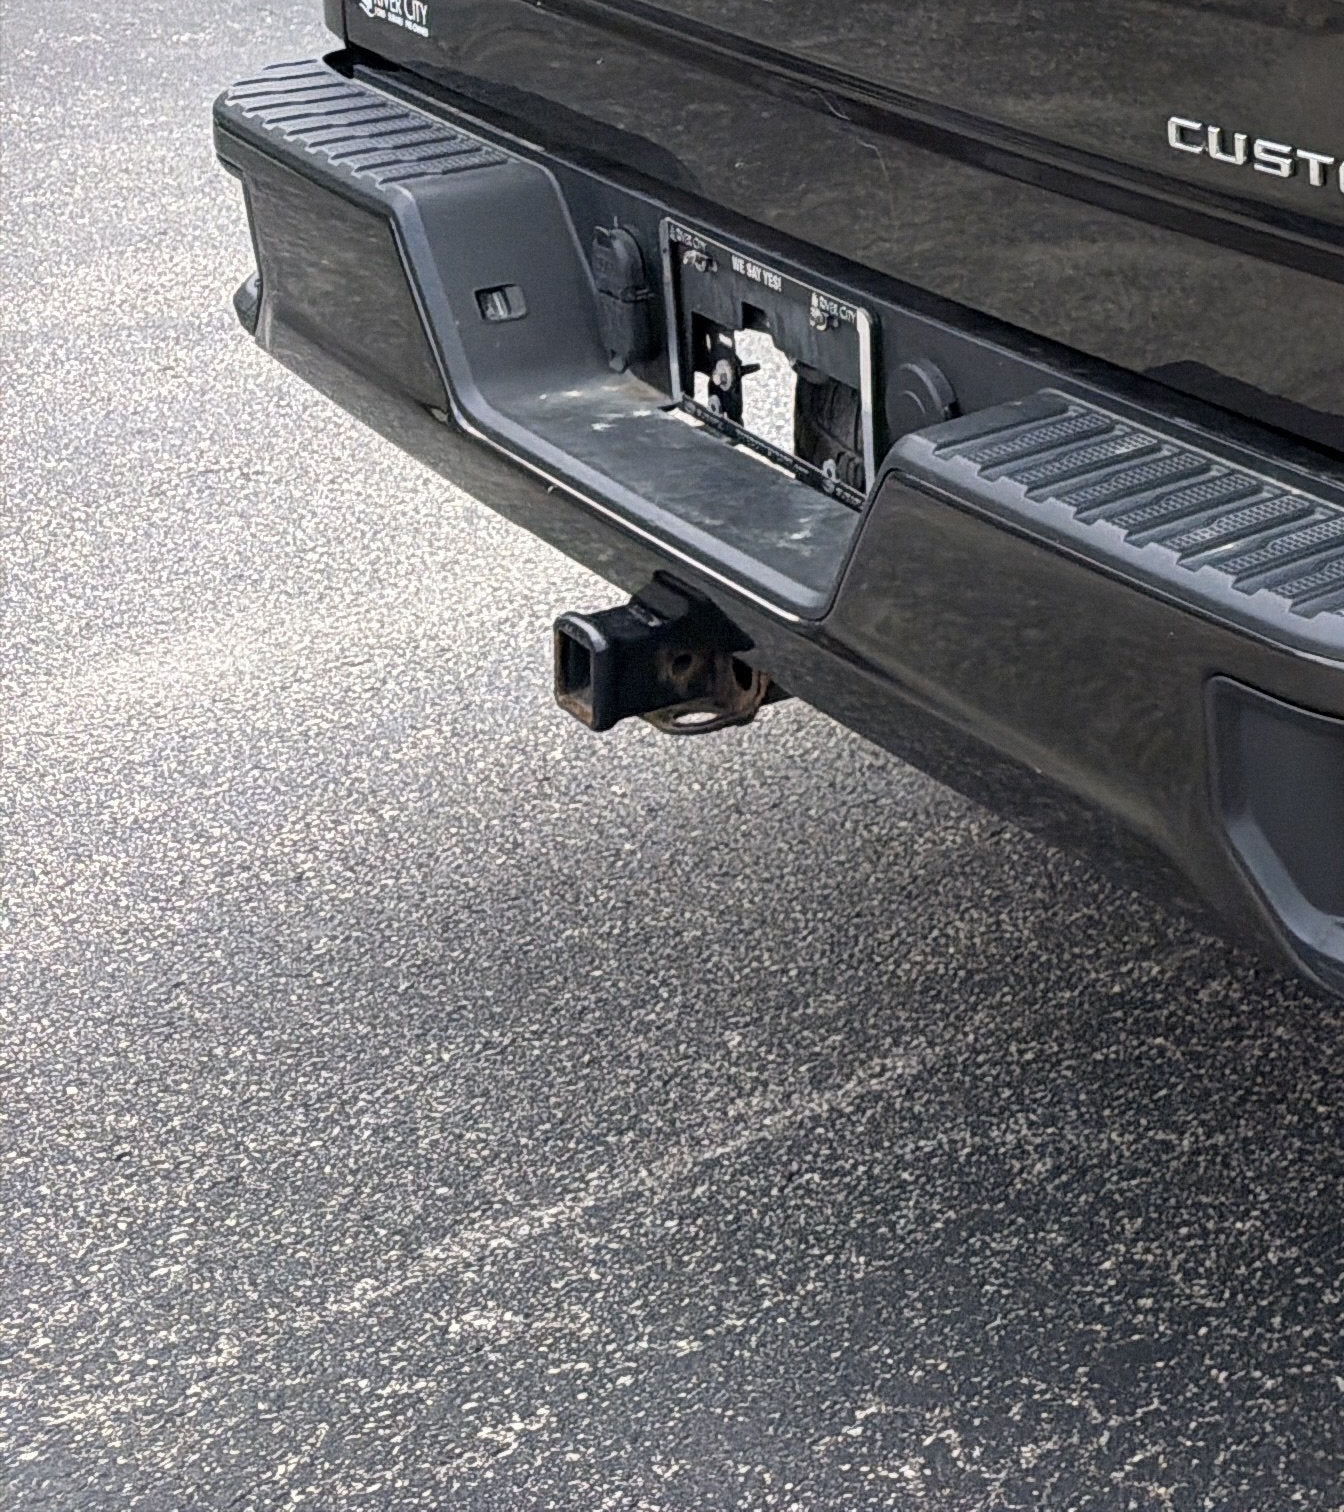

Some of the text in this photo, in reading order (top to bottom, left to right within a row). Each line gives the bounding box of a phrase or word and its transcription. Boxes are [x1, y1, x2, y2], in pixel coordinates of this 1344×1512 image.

[731, 254, 783, 293] WE SAY YES!
